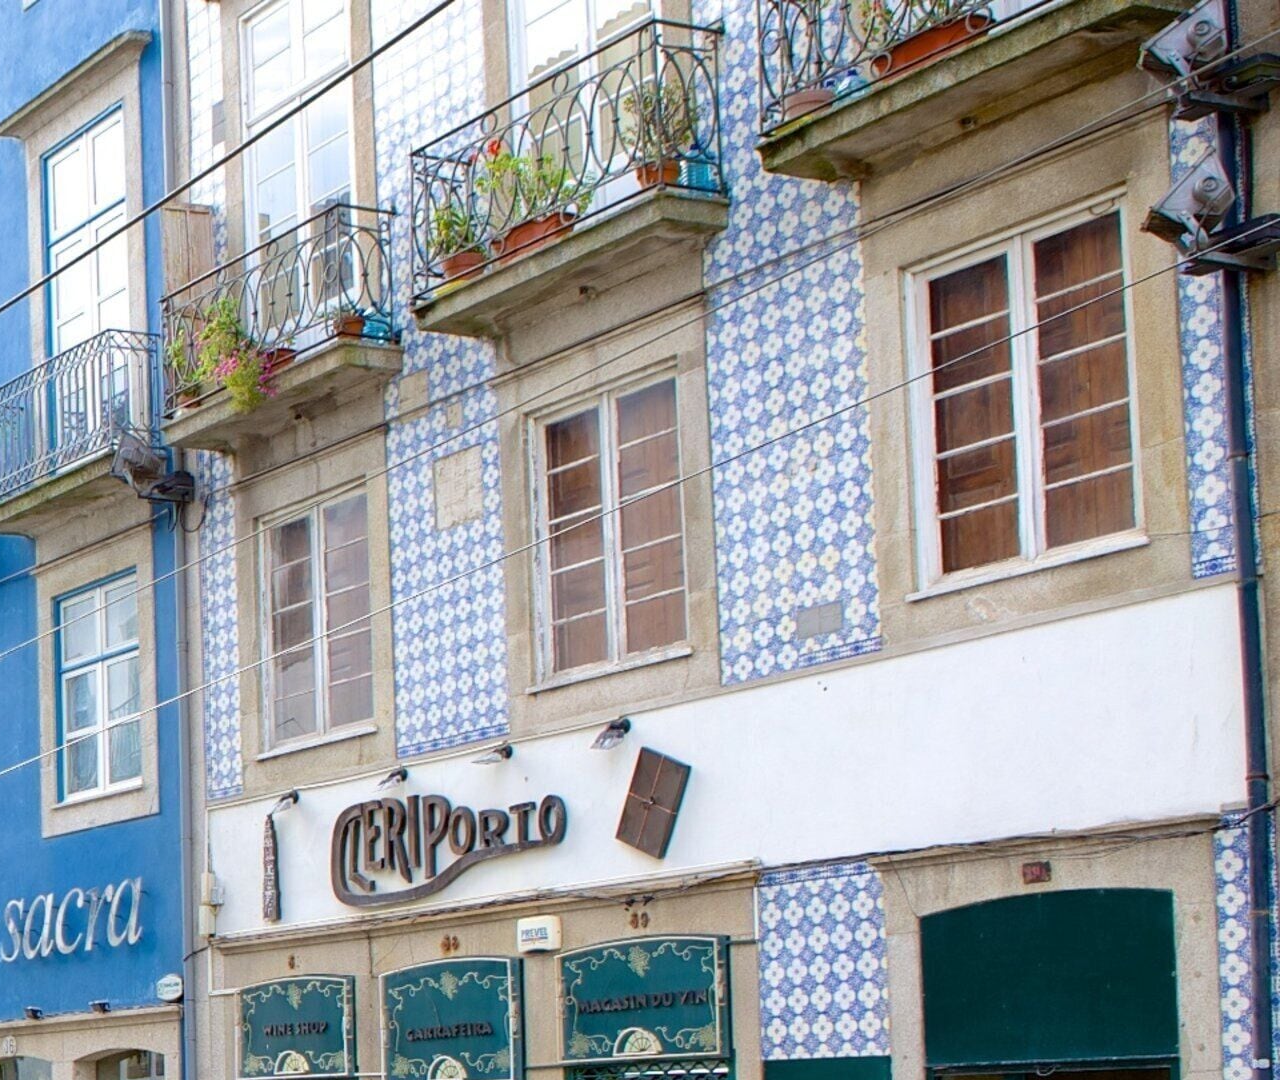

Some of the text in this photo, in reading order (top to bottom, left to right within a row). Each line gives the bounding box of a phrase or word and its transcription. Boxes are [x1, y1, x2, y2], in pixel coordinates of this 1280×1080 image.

[0, 877, 142, 963] sacra
[579, 989, 708, 1013] MAGASIN DU VIN
[263, 1021, 328, 1036] WINE SHOP
